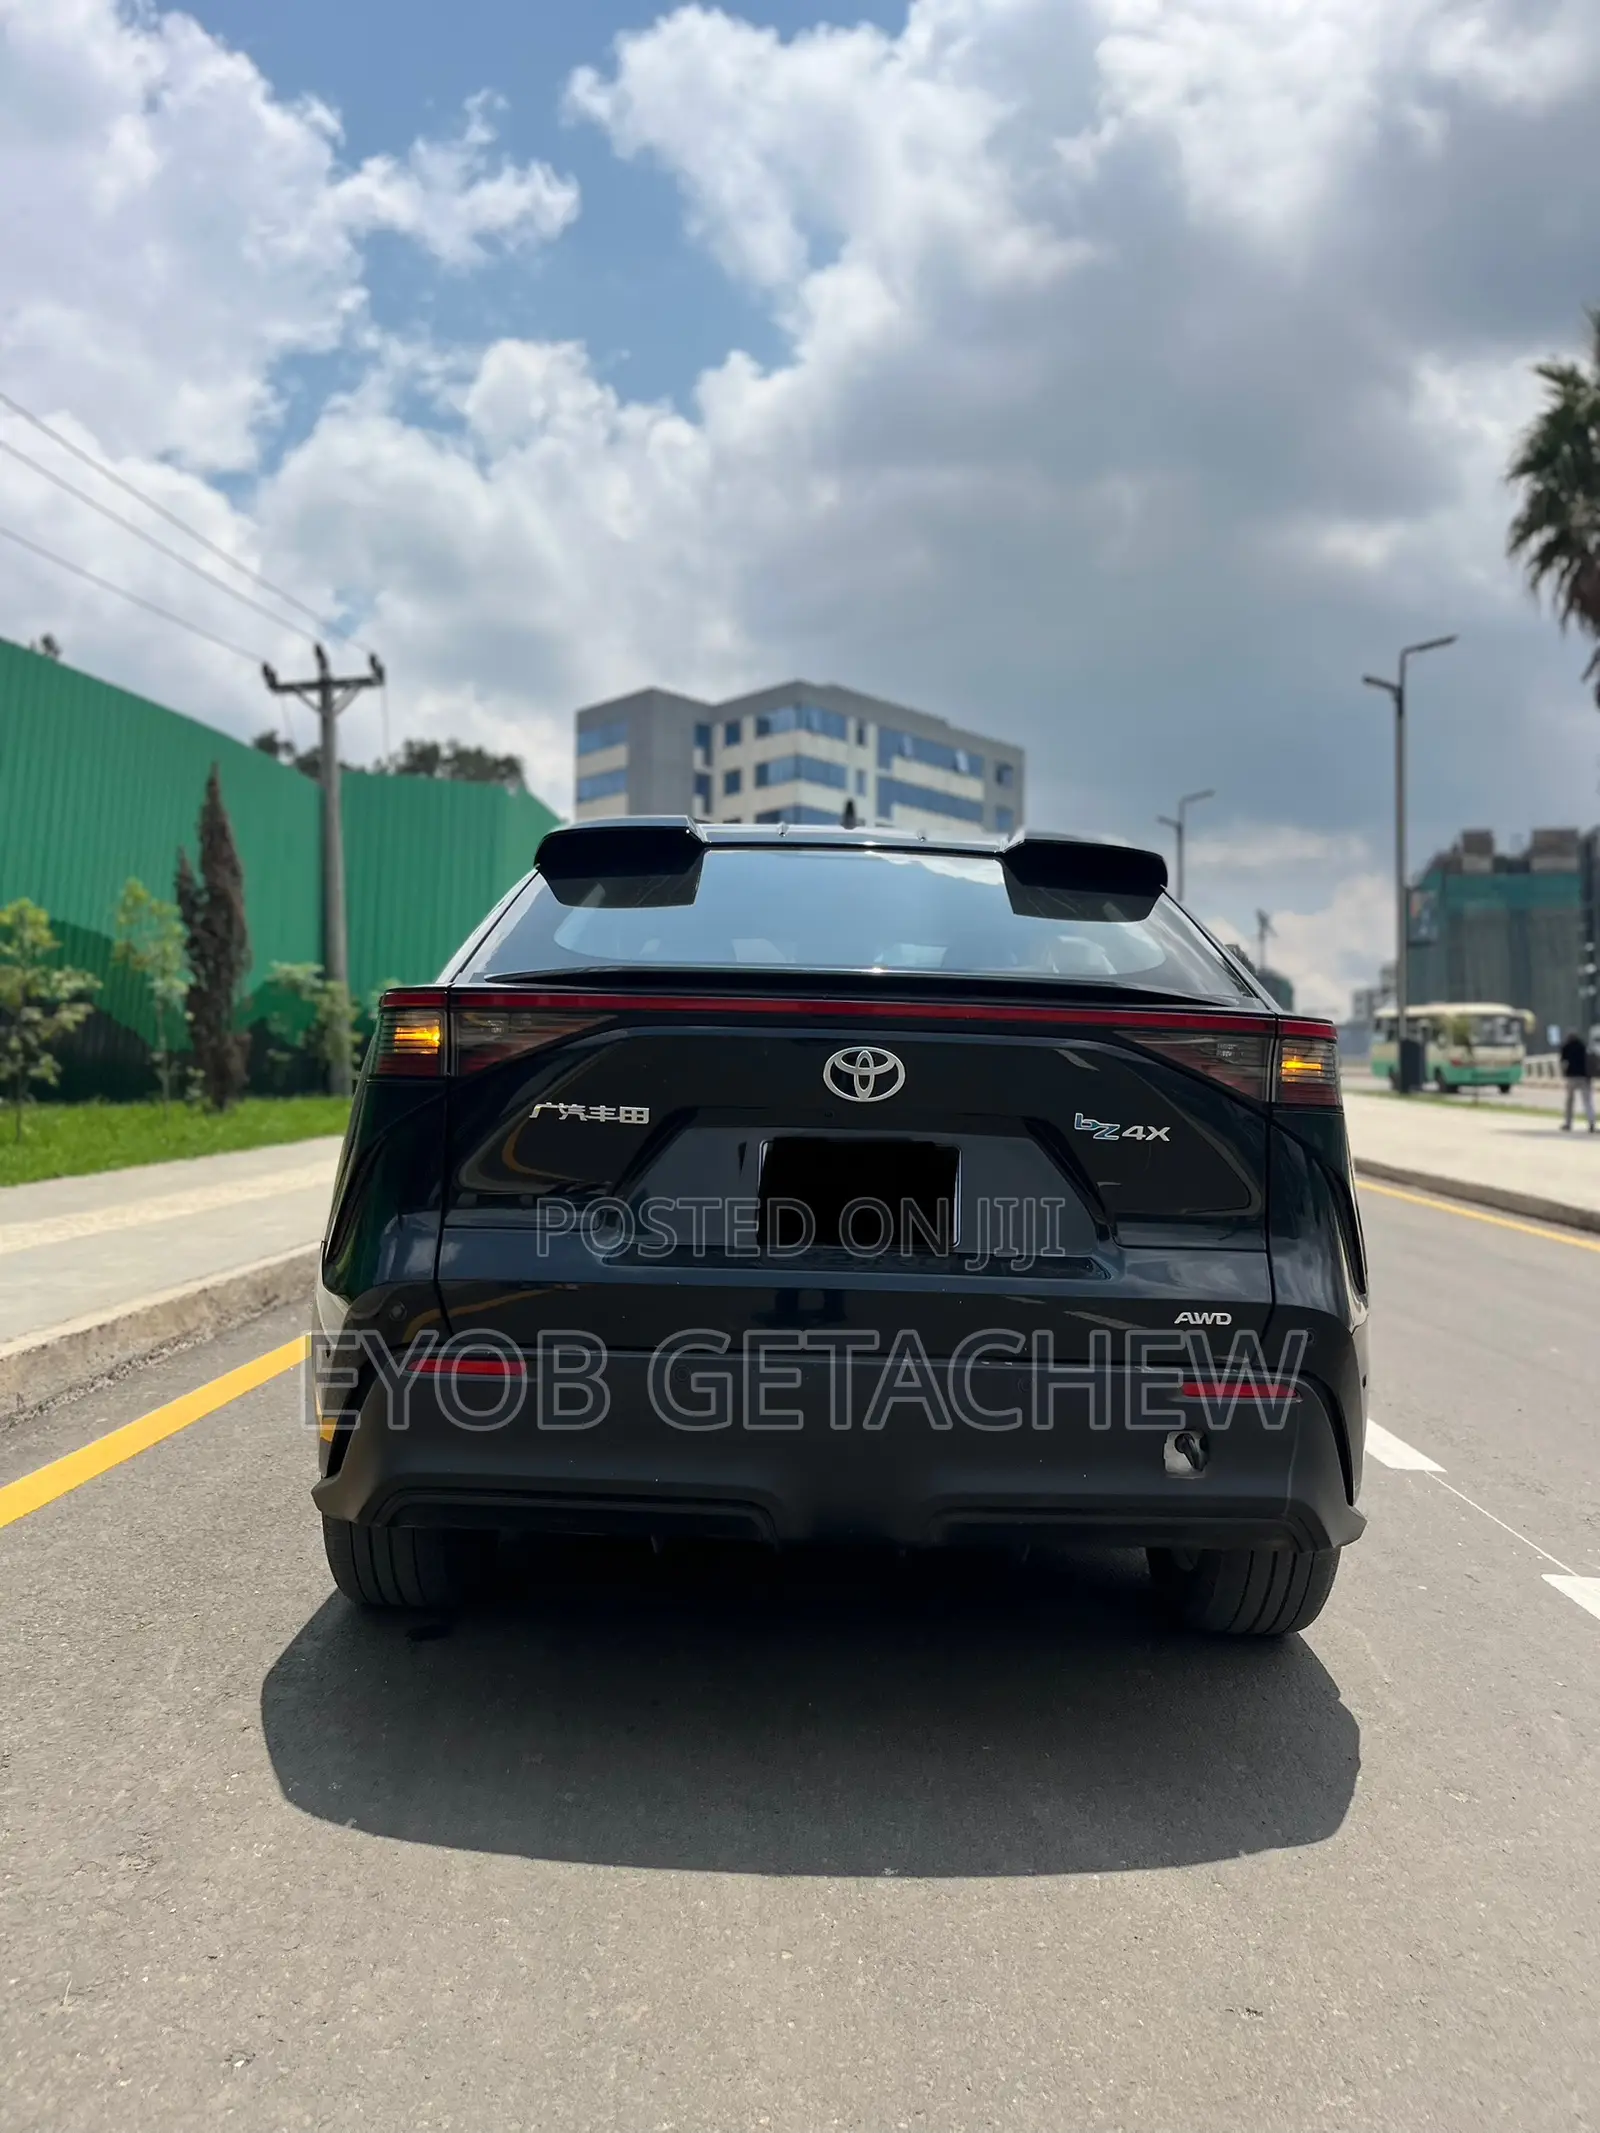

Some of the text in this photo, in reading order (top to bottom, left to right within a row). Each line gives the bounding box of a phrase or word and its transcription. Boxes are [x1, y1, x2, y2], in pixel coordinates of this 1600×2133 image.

[529, 1102, 650, 1124] 广汽丰田
[1174, 1312, 1232, 1325] AWD
